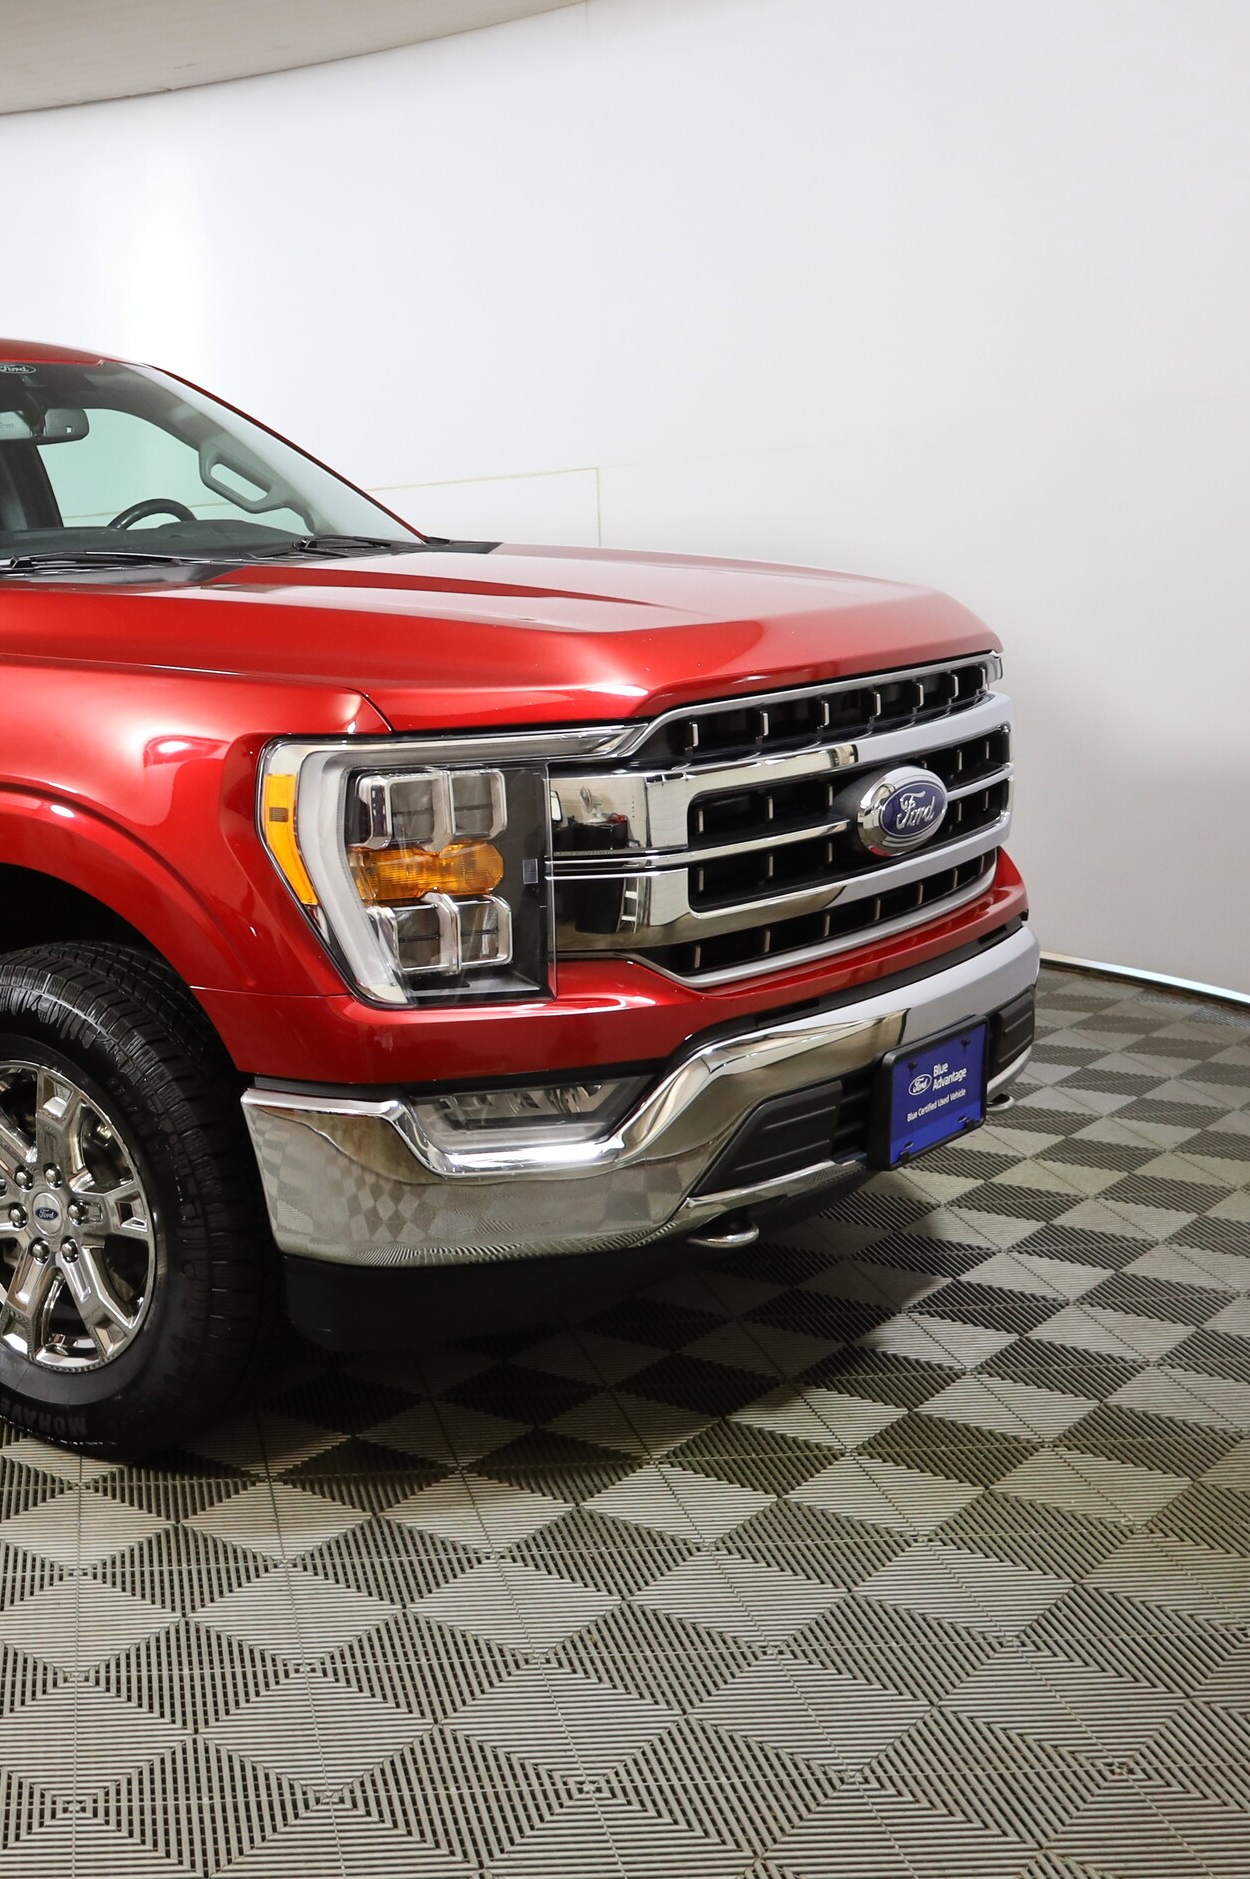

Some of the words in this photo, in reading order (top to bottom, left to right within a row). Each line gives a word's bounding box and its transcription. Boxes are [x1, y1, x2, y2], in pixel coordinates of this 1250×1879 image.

[896, 790, 936, 830] Ford
[932, 1067, 968, 1091] Advantage
[933, 1062, 949, 1077] Blue
[912, 1077, 929, 1093] Ford
[907, 1111, 918, 1122] Blue
[917, 1100, 938, 1117] Certified
[937, 1094, 950, 1107] Used
[950, 1088, 967, 1101] Vehicle
[39, 1209, 55, 1219] Ford
